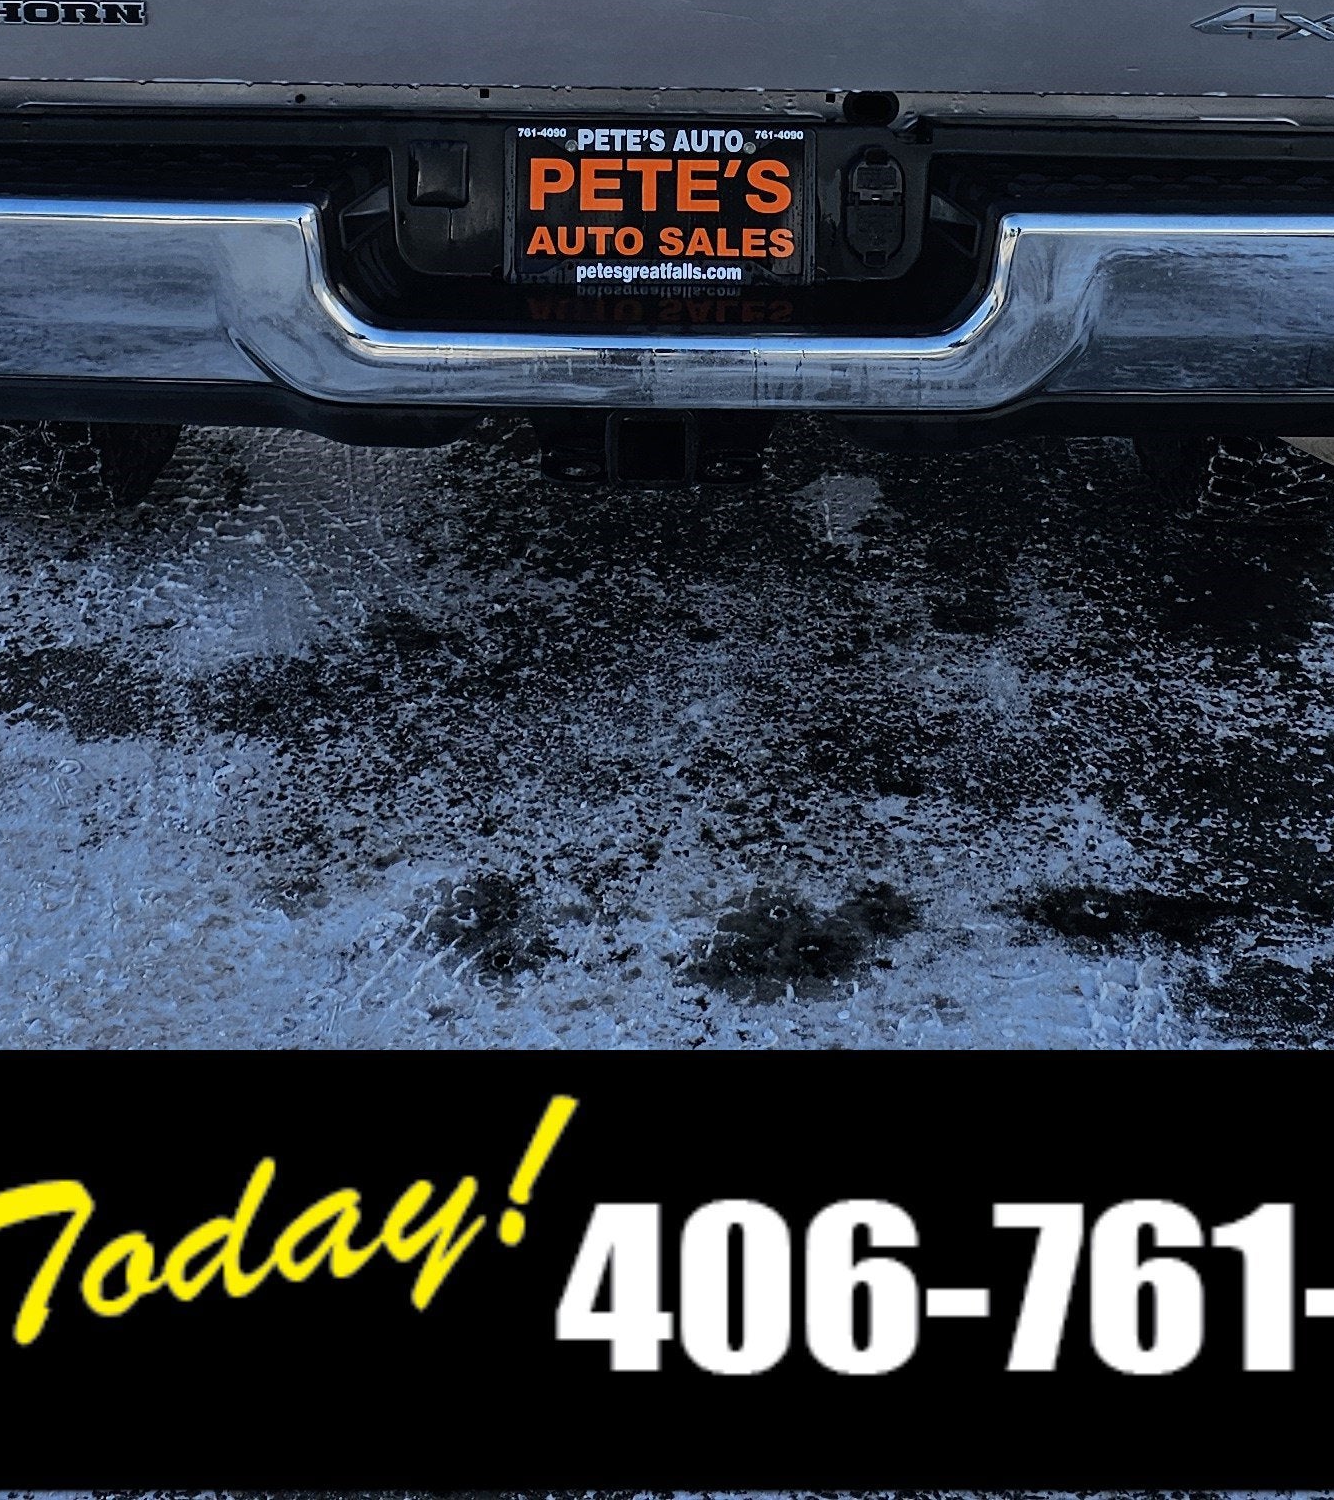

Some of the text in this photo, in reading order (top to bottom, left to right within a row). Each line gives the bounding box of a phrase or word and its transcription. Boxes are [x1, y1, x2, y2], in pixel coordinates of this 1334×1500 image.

[517, 127, 567, 138] 761-4090
[577, 128, 744, 153] PETE'S AUTO
[754, 130, 804, 140] 761-4090
[529, 157, 792, 214] PETE'S
[526, 226, 795, 258] AUTO SALES
[576, 263, 742, 283] petesgreatfalls.com
